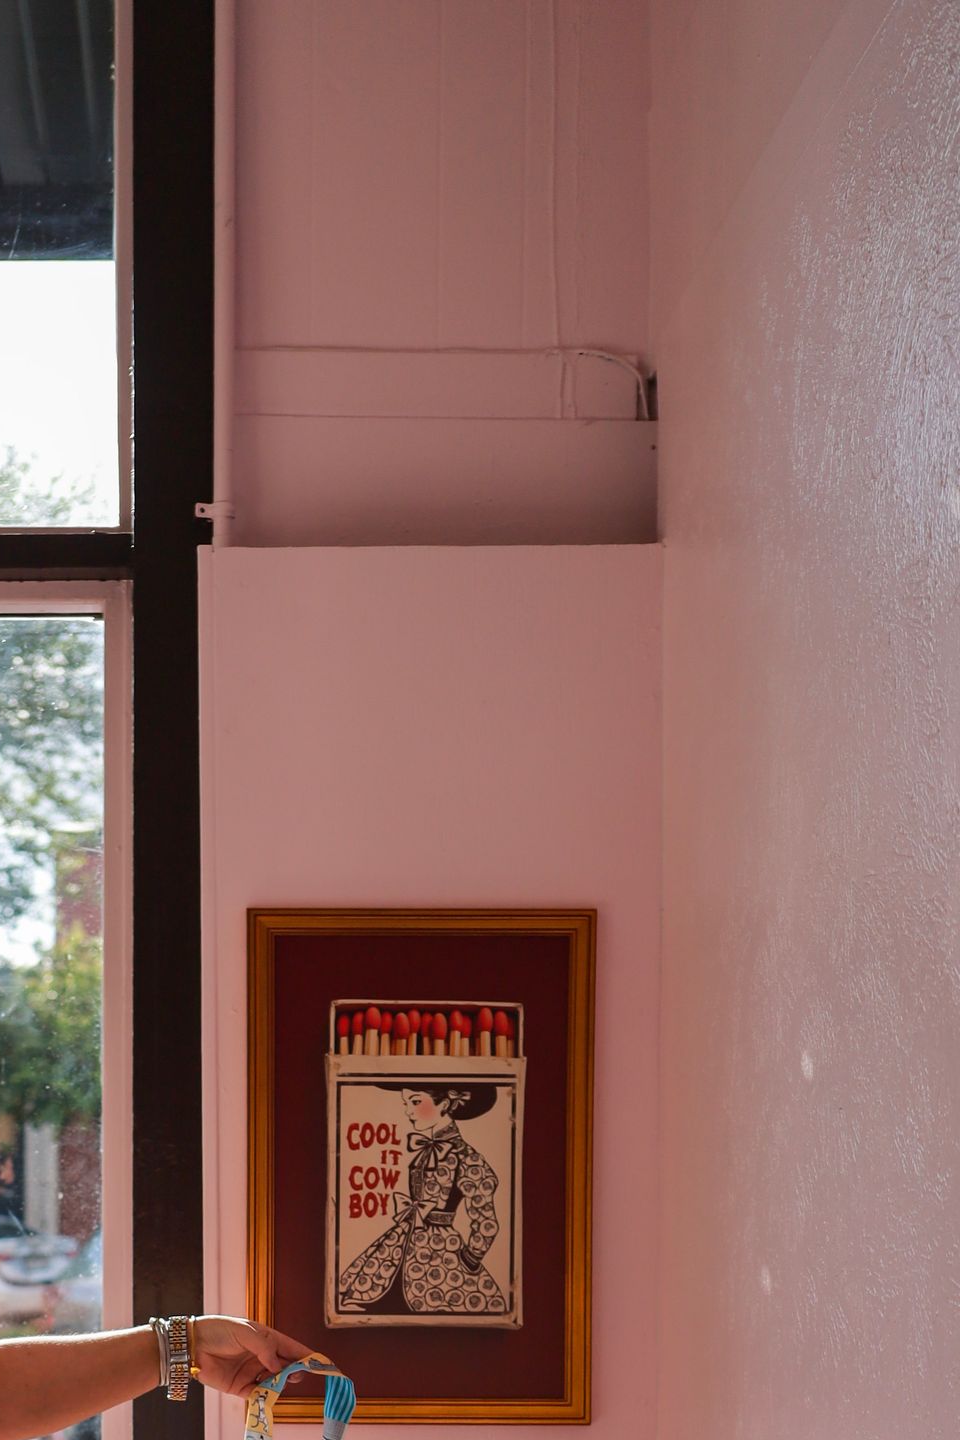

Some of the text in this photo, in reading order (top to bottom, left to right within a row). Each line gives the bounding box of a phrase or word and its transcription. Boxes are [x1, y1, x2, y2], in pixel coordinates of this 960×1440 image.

[346, 1122, 401, 1151] COOL
[380, 1150, 403, 1166] IT
[348, 1165, 401, 1191] COW
[349, 1191, 390, 1219] BOY
